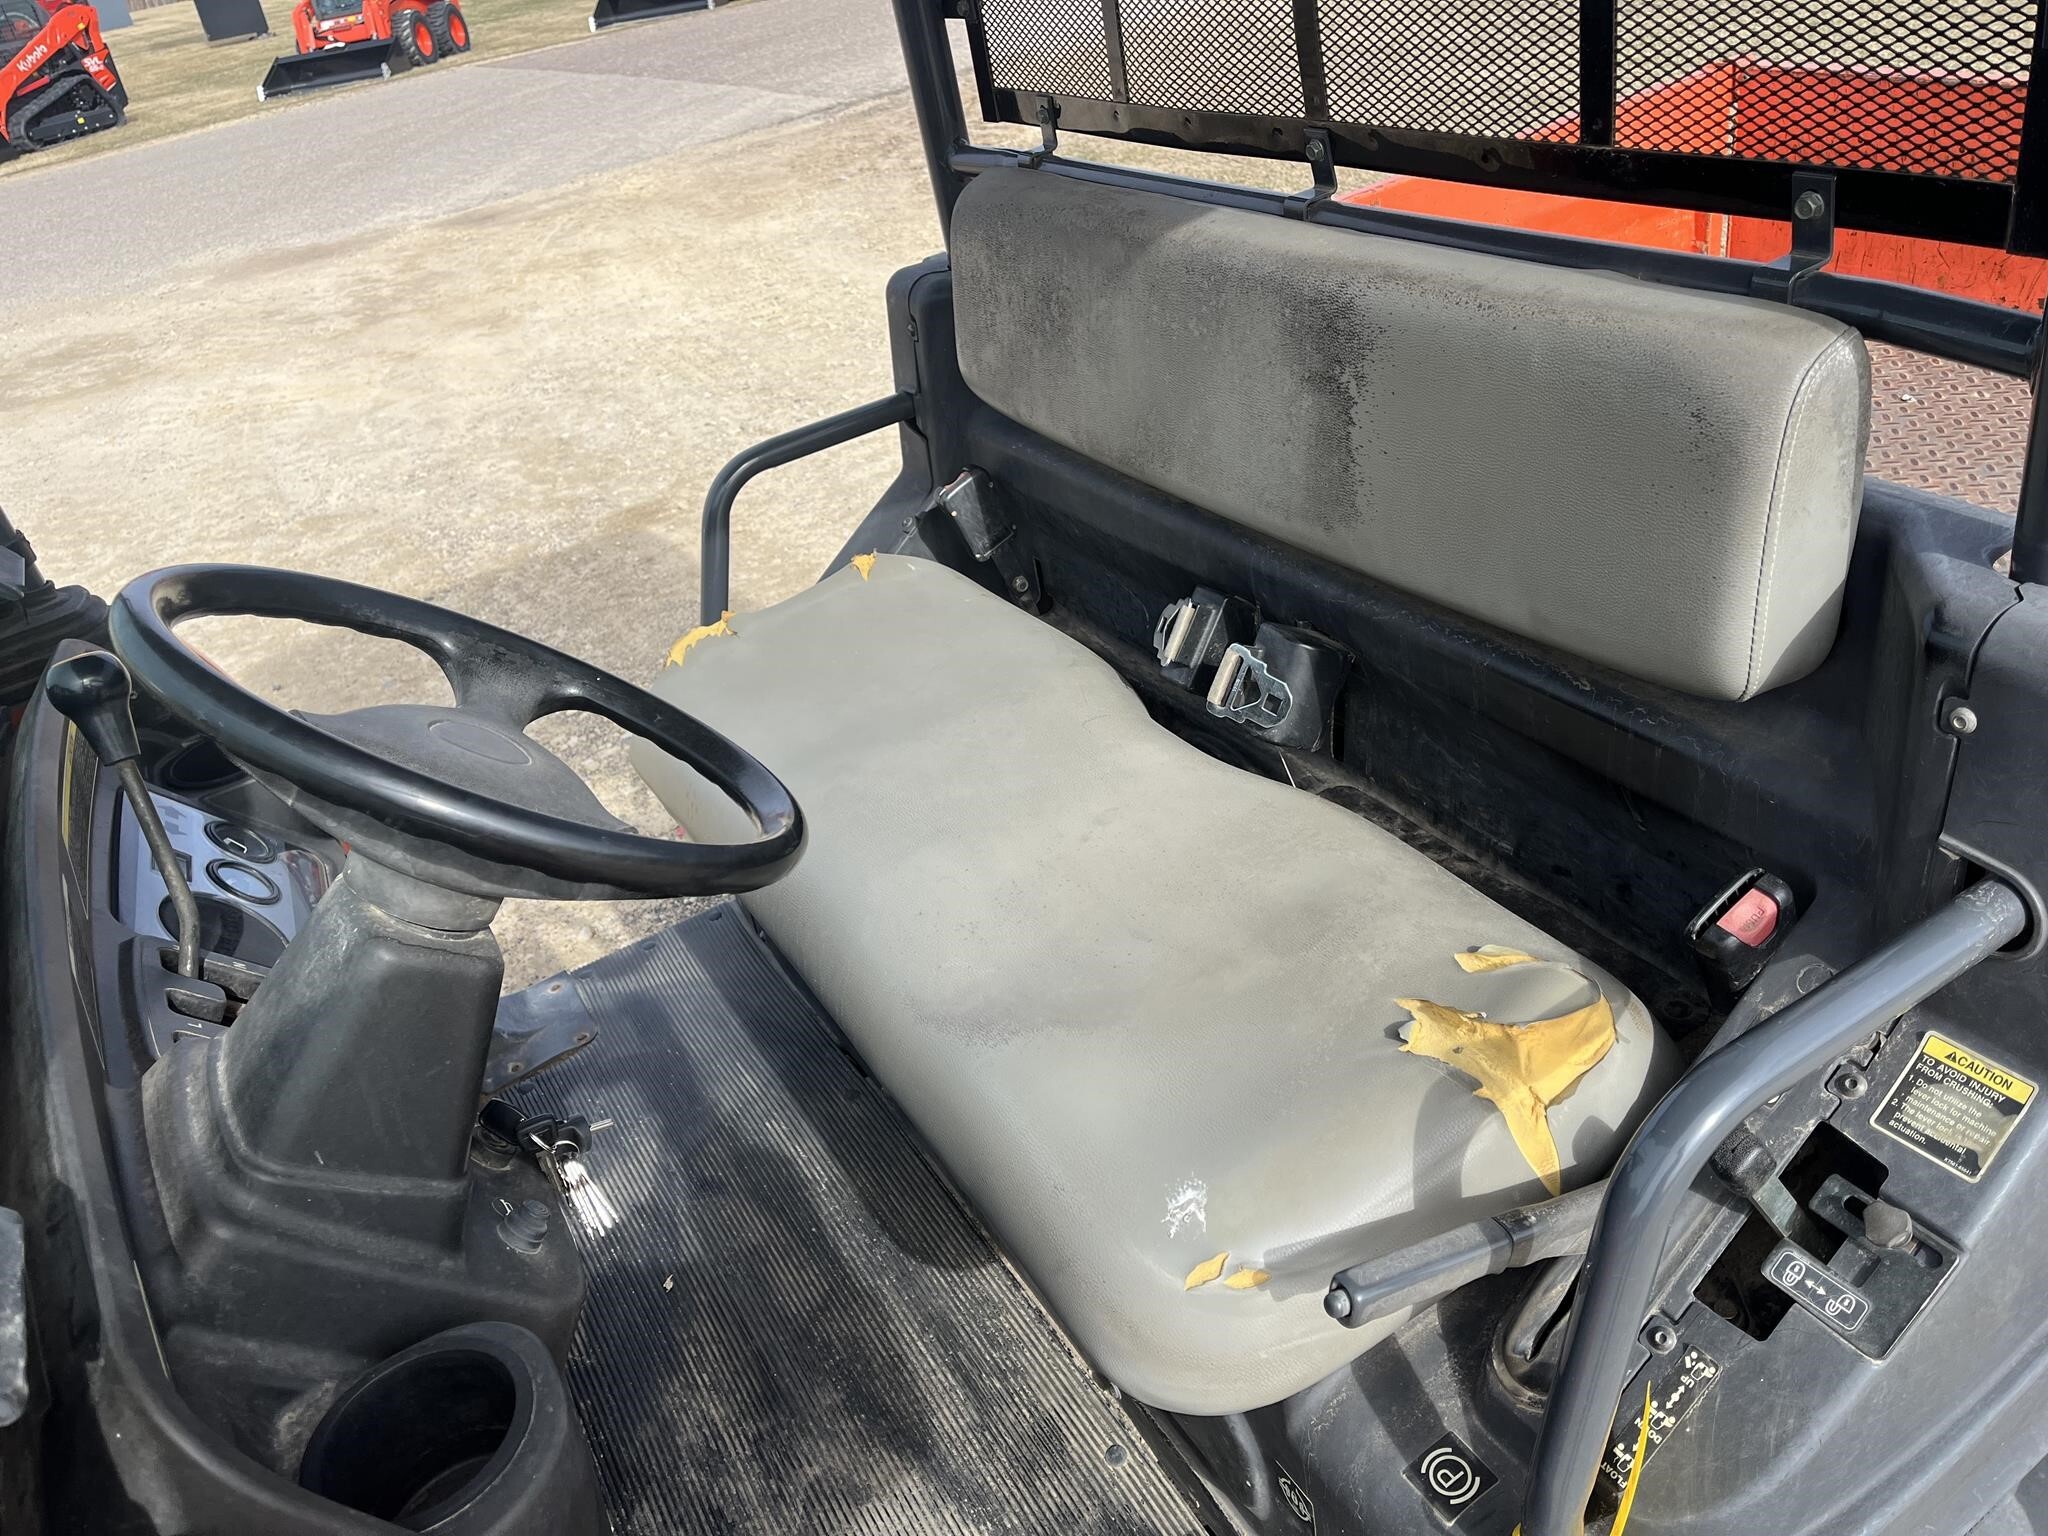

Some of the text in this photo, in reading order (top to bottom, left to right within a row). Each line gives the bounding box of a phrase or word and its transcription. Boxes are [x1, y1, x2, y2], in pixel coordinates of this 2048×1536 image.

[16, 44, 48, 72] Kubota
[82, 56, 101, 68] SVL
[1916, 1063, 1995, 1109] FROM CRUSHING:
[1922, 1056, 2006, 1104] TO AVOID INJURY
[1957, 1056, 2013, 1091] CAUTION
[1905, 1096, 1956, 1126] maintenance
[1916, 1079, 1929, 1089] Do
[1929, 1086, 1944, 1097] not
[1943, 1094, 1968, 1110] utilize
[1968, 1107, 1983, 1118] the
[1892, 1099, 1900, 1107] 2.
[1901, 1104, 1916, 1115] The
[1916, 1112, 1936, 1126] lever
[1894, 1112, 1925, 1132] prevent
[1911, 1088, 1998, 1137] lever lock for machine
[1888, 1120, 1928, 1145] actuation.
[1680, 1375, 1694, 1388] UP
[1634, 1417, 1662, 1444] DON
[1600, 1462, 1628, 1488] FLOAT
